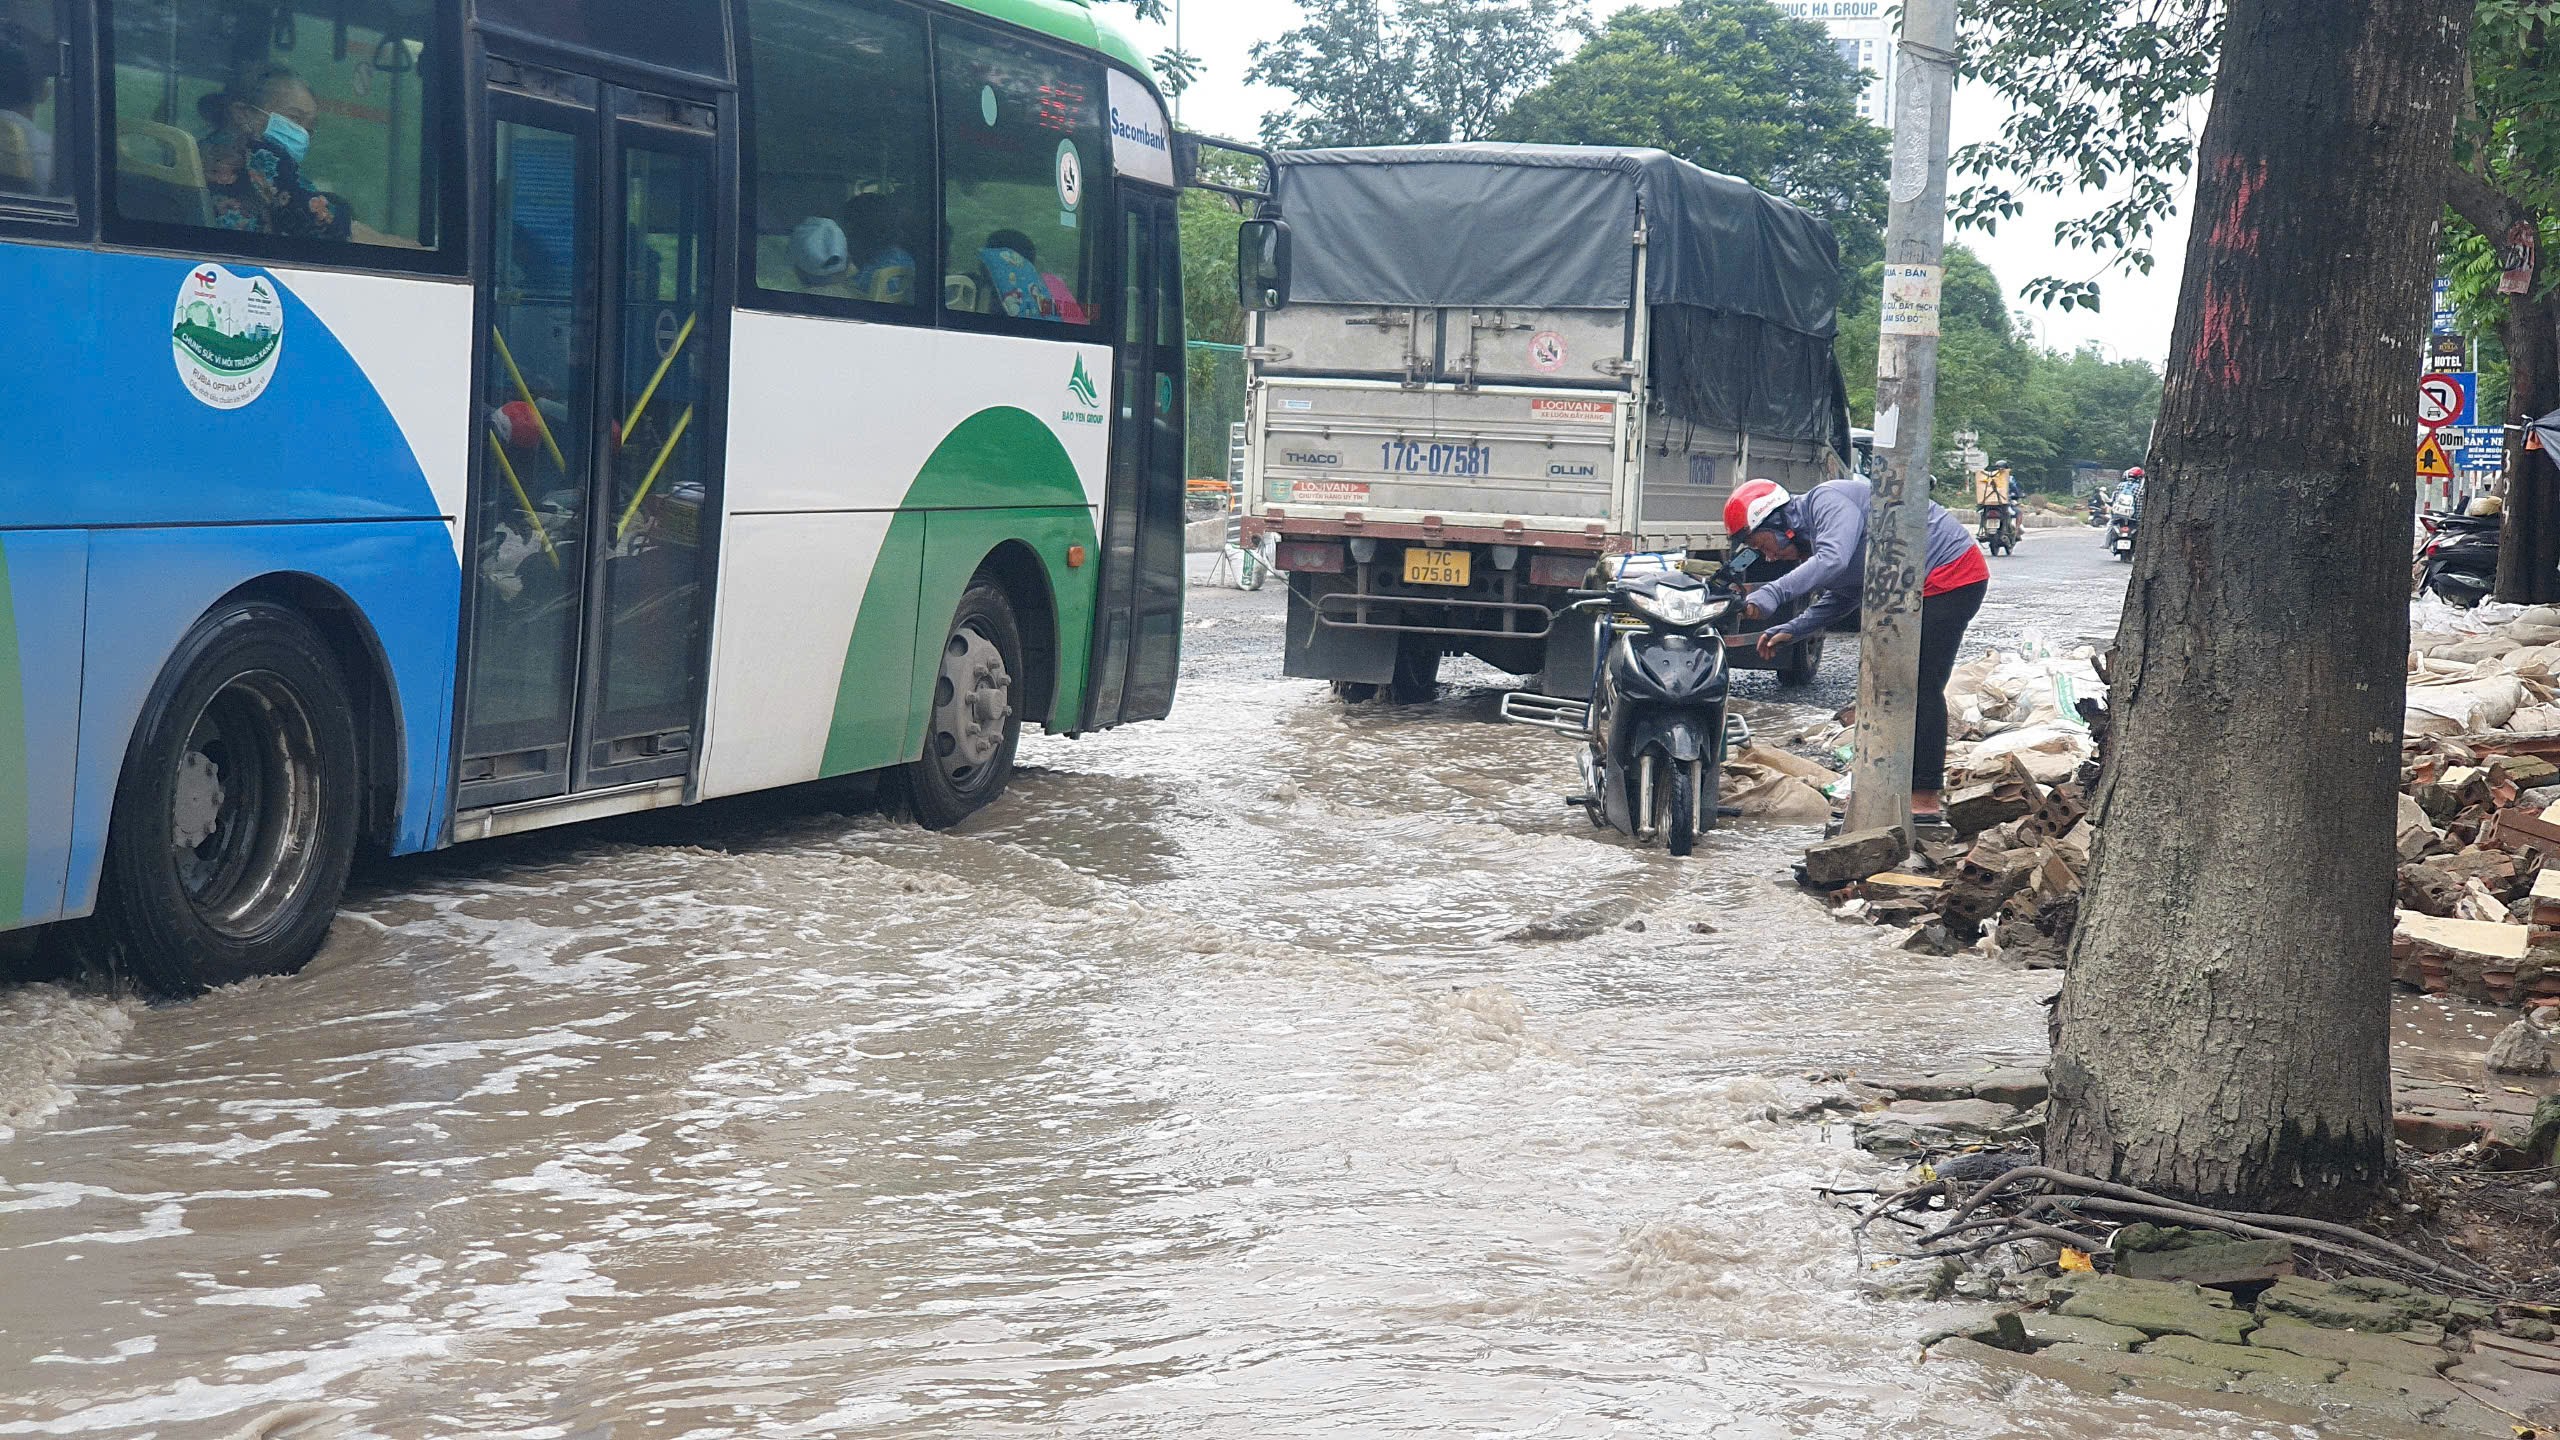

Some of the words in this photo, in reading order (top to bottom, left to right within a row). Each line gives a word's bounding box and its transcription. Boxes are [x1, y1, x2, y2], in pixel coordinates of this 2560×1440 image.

[1812, 3, 1829, 16] HA
[1834, 2, 1878, 16] GROUP
[1111, 107, 1166, 152] Sacombank
[1904, 267, 1927, 277] BÁN
[2438, 279, 2451, 287] RO
[181, 332, 202, 353] CHUNG
[258, 341, 275, 359] XANH
[2434, 356, 2462, 367] HOTEL
[192, 368, 212, 387] RUBIA
[212, 381, 237, 392] OPTIMA
[1541, 401, 1592, 411] LOGIVAN
[1062, 411, 1075, 421] BAO
[1075, 413, 1085, 422] YEN
[1086, 414, 1104, 424] GROUP
[1286, 452, 1338, 464] THACO
[1381, 441, 1491, 475] 17C-07581
[1550, 464, 1594, 475] OLLIN
[1426, 551, 1451, 565] 17C
[1411, 566, 1461, 583] 075.81
